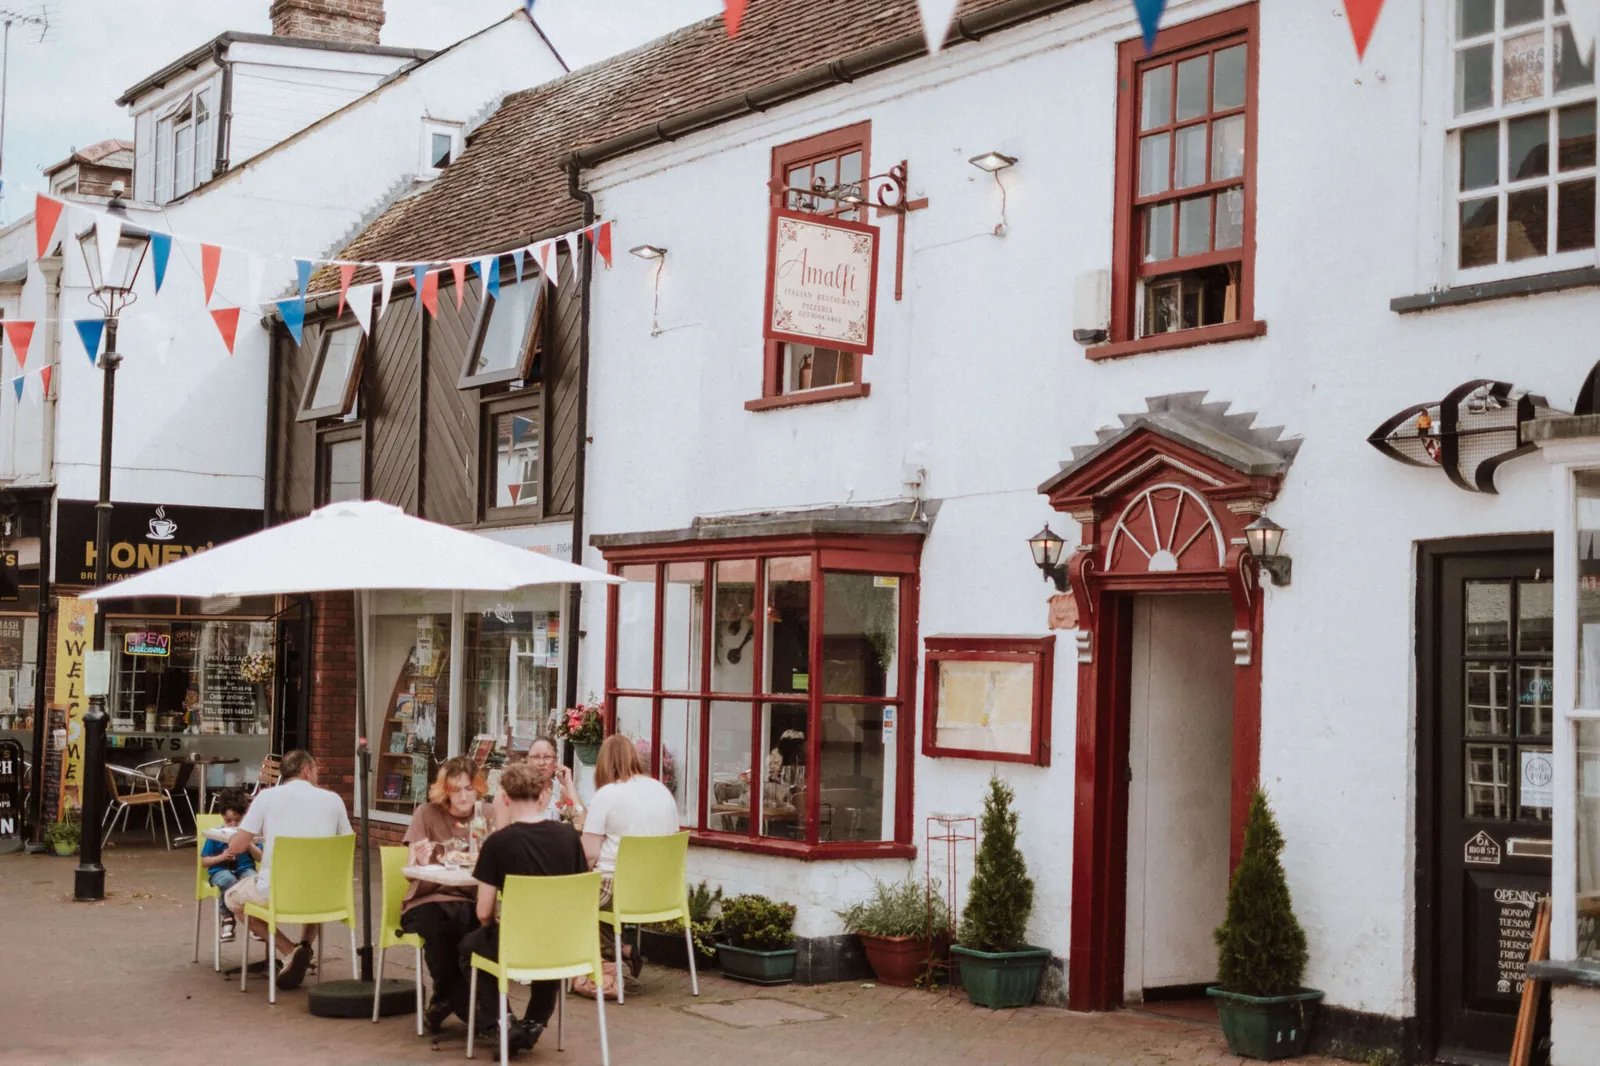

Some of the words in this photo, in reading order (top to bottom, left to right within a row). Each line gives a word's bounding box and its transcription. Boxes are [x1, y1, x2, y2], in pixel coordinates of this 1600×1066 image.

[777, 247, 856, 297] Amalfi
[784, 287, 812, 299] ITALIAN
[817, 293, 861, 308] RESTAURANT
[802, 302, 833, 314] PIZZERIA
[0, 552, 16, 566] 'S
[80, 572, 136, 581] BRKFAS
[0, 620, 19, 630] ASH
[128, 631, 168, 648] OPEN
[1476, 835, 1490, 846] 6A
[1469, 846, 1486, 854] HIGH
[1486, 847, 1498, 855] ST.
[1494, 888, 1541, 902] OPENING
[1500, 907, 1532, 918] MONDAY
[1498, 918, 1532, 928] TUESDAY
[1500, 928, 1534, 938] WEDNES
[1498, 940, 1532, 950] THURSD
[1500, 950, 1526, 960] FRIDAY
[1498, 960, 1525, 970] SATUR
